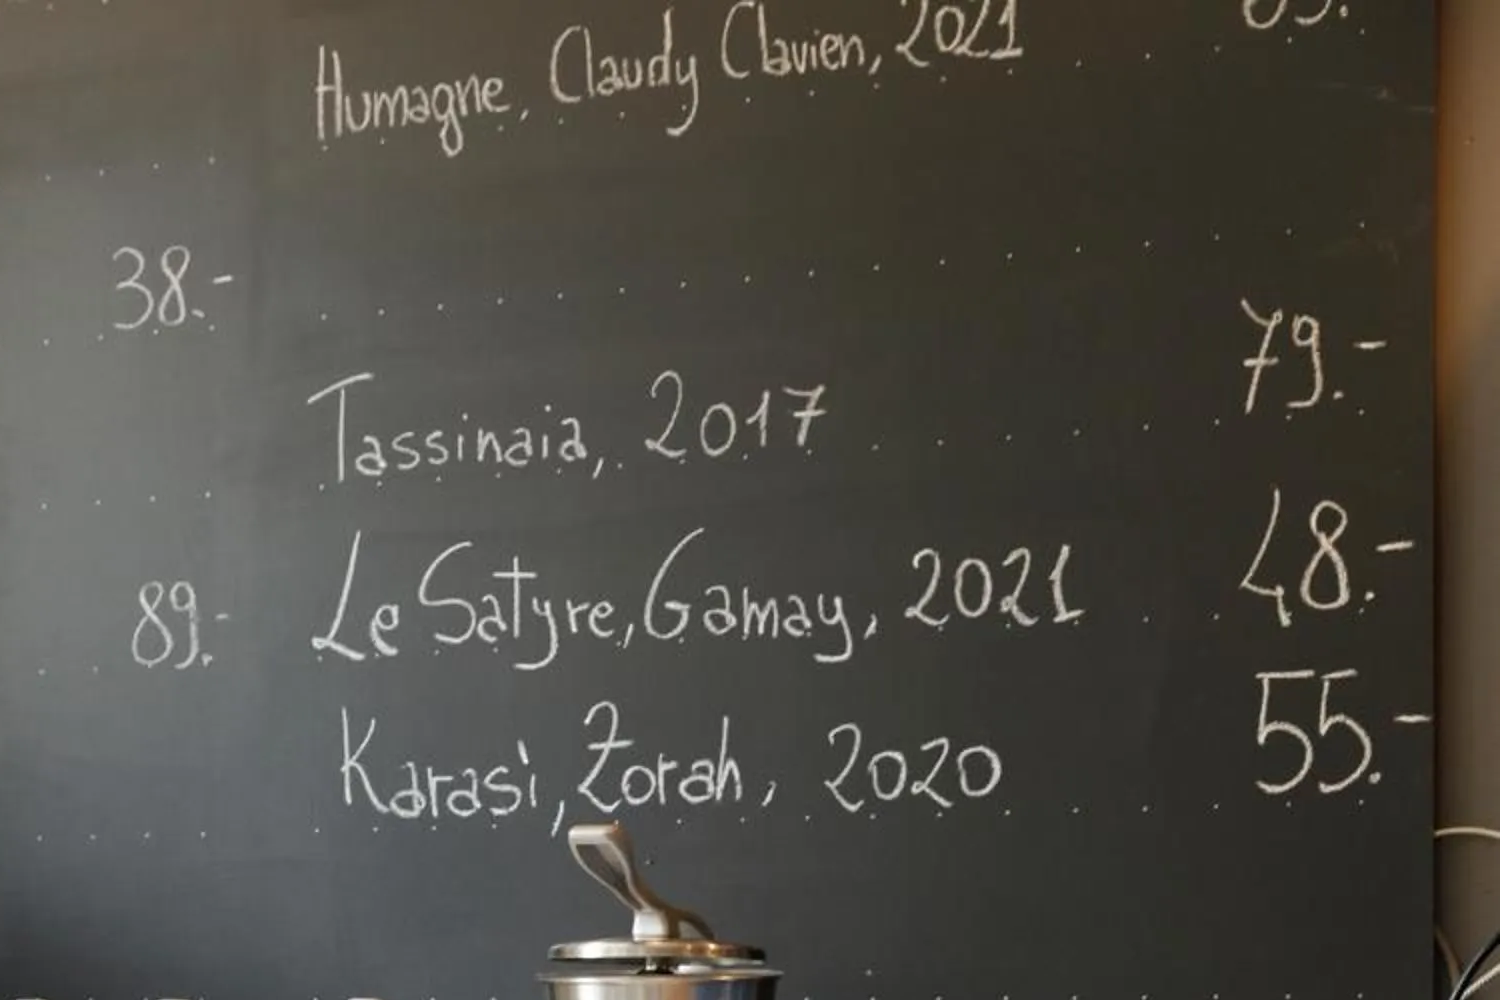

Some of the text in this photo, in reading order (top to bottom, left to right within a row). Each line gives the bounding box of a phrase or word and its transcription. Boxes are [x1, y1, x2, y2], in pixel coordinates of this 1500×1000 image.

[314, 0, 1025, 157] Humagne, Claudy Clavien, 2021
[306, 372, 603, 482] Tassinaia,
[645, 370, 827, 458] 2017
[311, 530, 401, 661] Le
[418, 541, 634, 671] Satyre,
[643, 528, 879, 664] Gamay,
[904, 545, 1085, 627] 2021
[339, 706, 565, 837] Karasi,
[577, 701, 778, 815] Zorah,
[825, 723, 1003, 812] 2020
